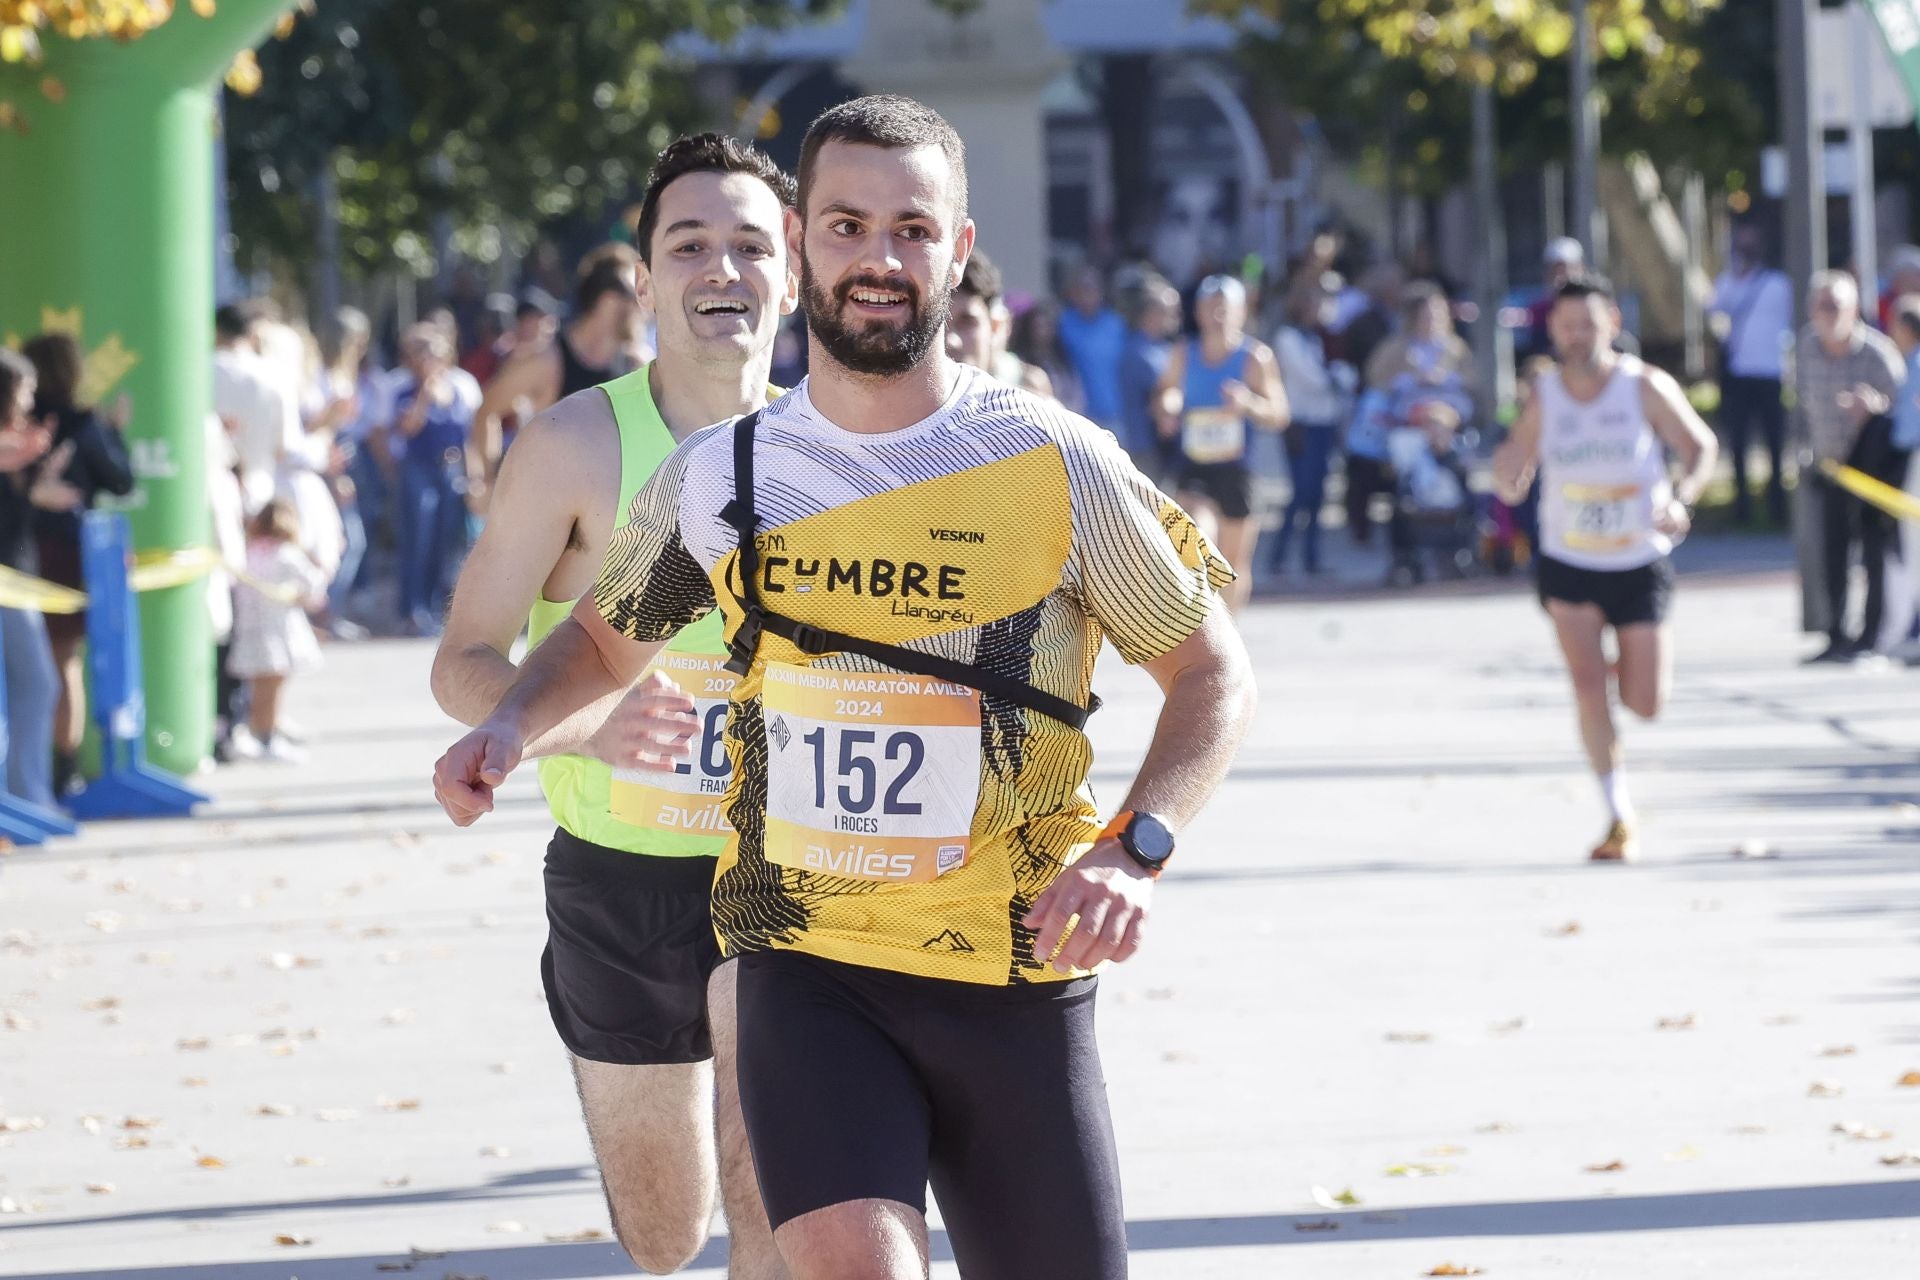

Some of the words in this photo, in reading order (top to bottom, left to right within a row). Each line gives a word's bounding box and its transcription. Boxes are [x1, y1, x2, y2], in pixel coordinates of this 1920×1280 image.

[929, 528, 985, 543] VESKIN
[763, 557, 966, 600] CUMBRE
[890, 600, 974, 624] Llangréu
[669, 657, 710, 671] MEDIA
[703, 678, 736, 693] 202
[798, 673, 840, 690] MEDIA
[842, 678, 920, 695] MARATÓN
[834, 700, 884, 717] 2024
[803, 726, 925, 816] 152
[656, 804, 736, 832] avil
[834, 815, 840, 830] I
[841, 815, 878, 833] ROCES
[804, 843, 915, 878] avilés
